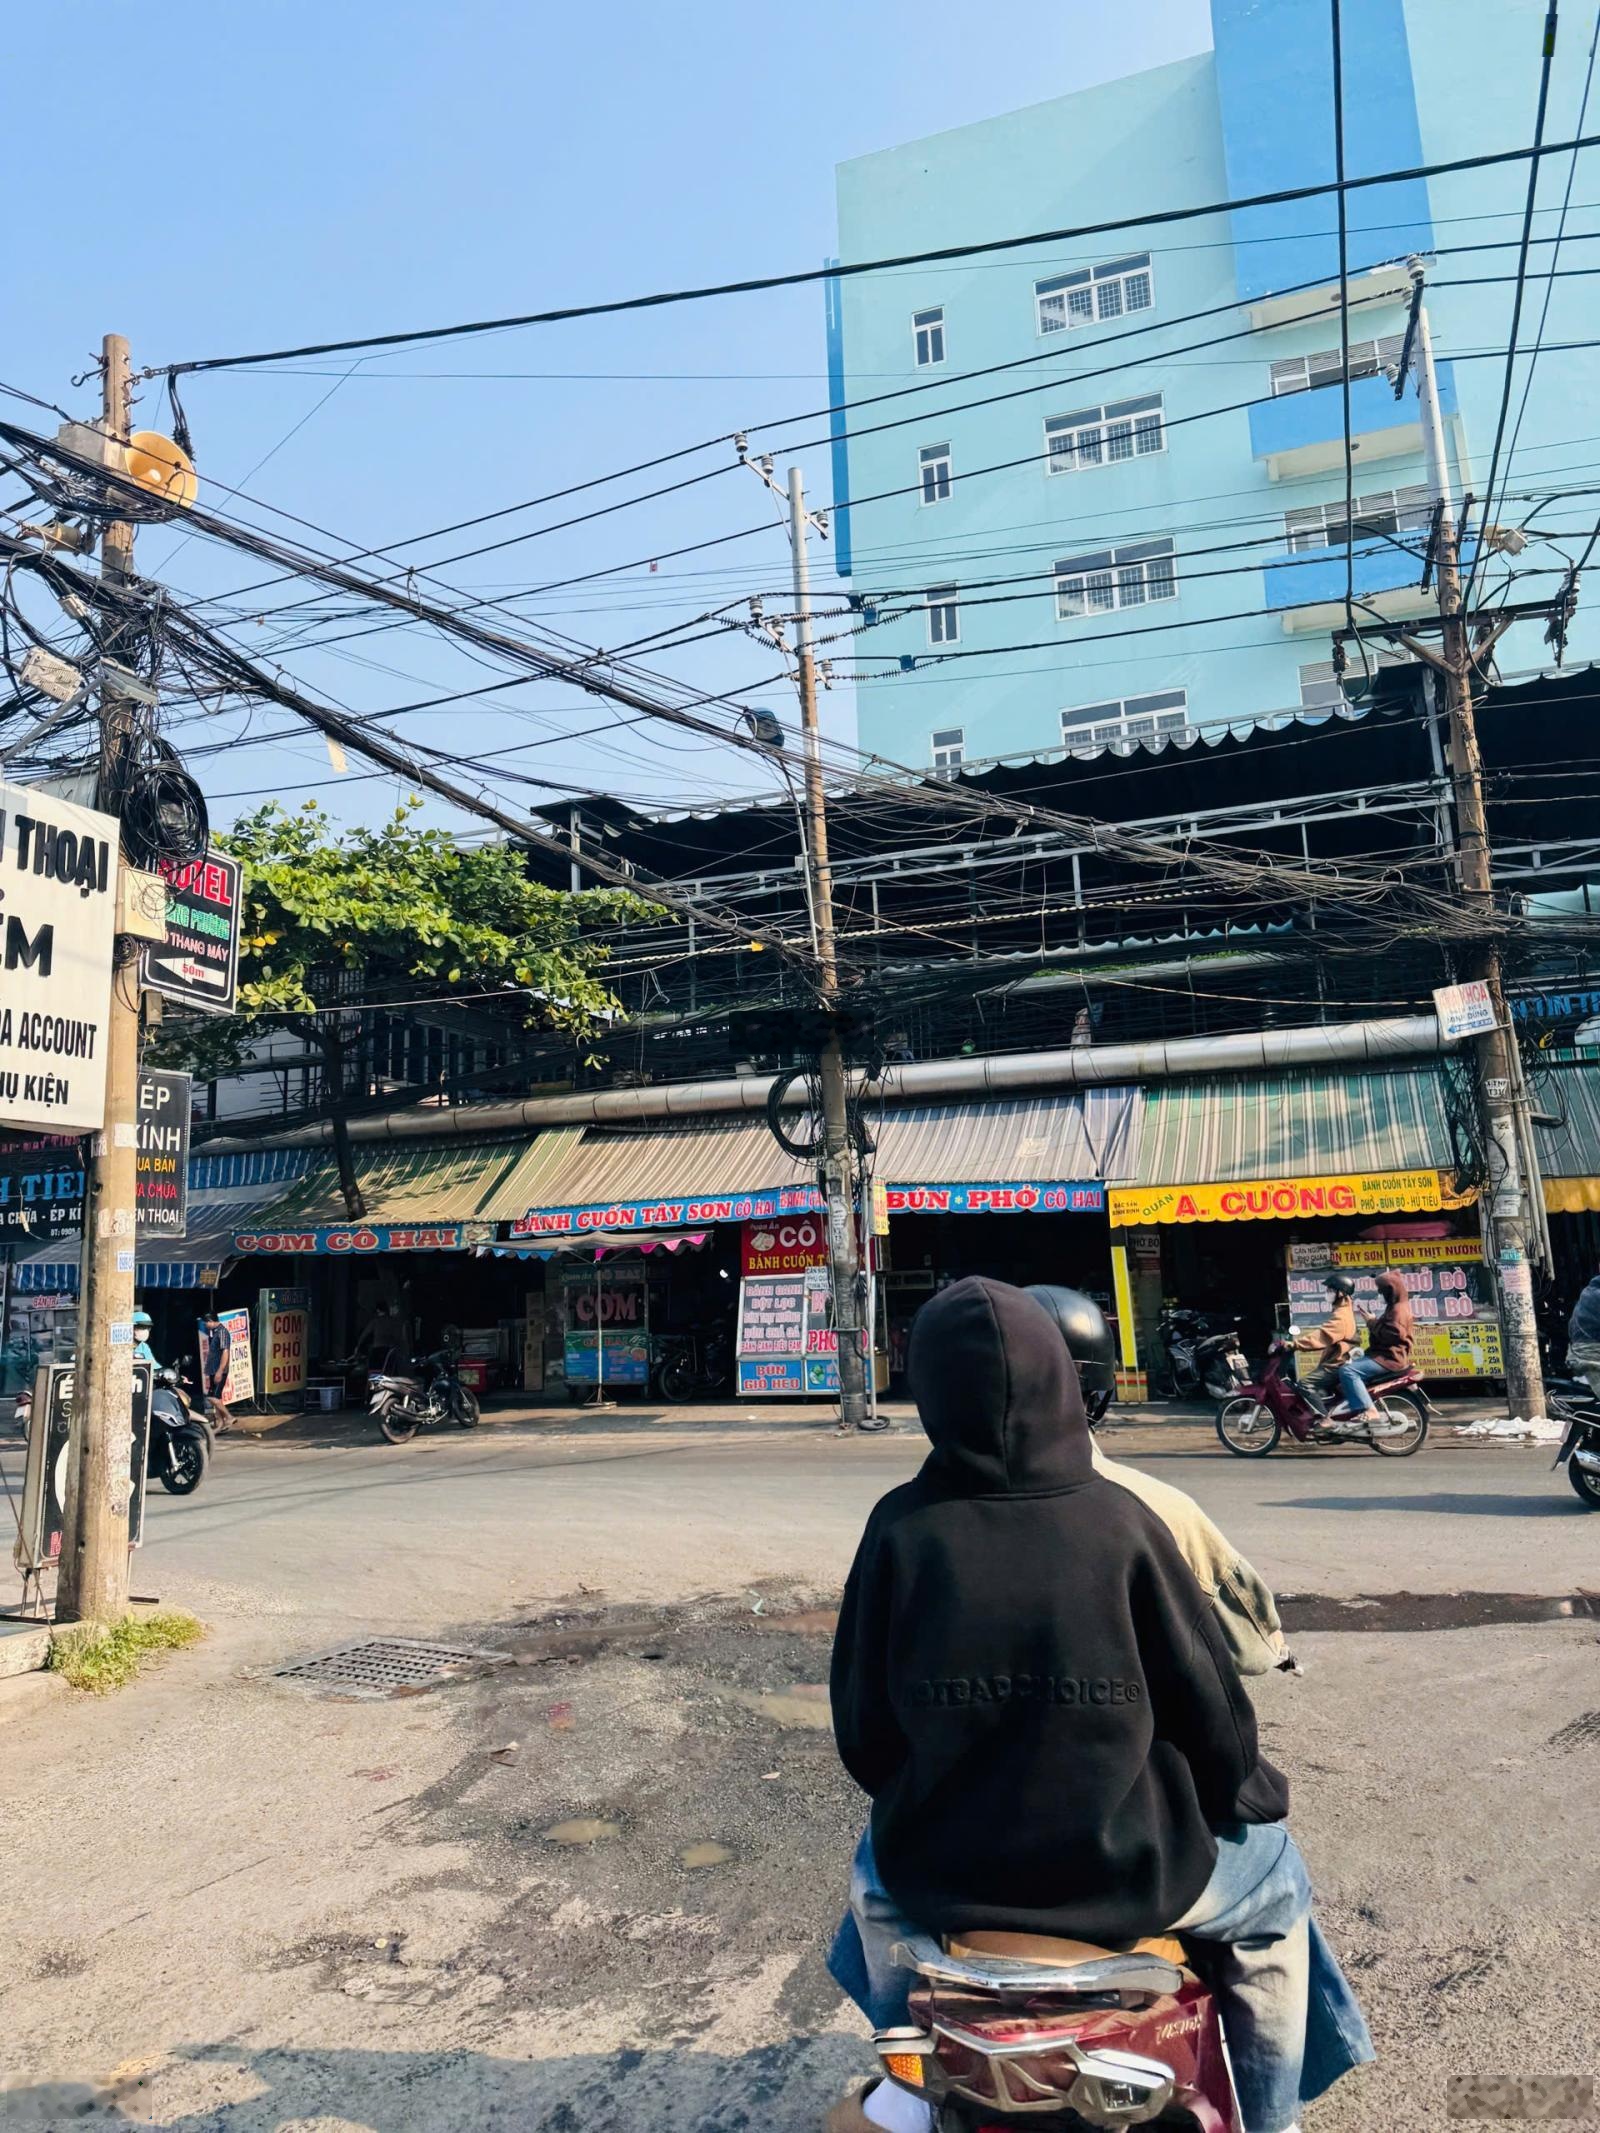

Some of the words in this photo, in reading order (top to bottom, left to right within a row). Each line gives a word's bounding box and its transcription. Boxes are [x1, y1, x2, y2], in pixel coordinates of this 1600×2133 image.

[15, 815, 109, 898] THOẠI
[170, 932, 205, 956] THANG
[207, 943, 229, 963] MÁY
[18, 1012, 97, 1060] ACCOUNT
[25, 1072, 69, 1108] KIỆN
[140, 1079, 171, 1111] ÉP
[137, 1160, 151, 1172] UA
[887, 1187, 951, 1209] BÚN
[967, 1184, 1041, 1209] PHỞ
[1044, 1187, 1067, 1209] CÔ
[1072, 1189, 1101, 1208] HAI
[1221, 1183, 1356, 1217] CƯỜNG
[50, 1203, 65, 1222] ÉP
[149, 1209, 179, 1227] THOẠI
[576, 1204, 636, 1229] CUỐN
[641, 1202, 684, 1224] TÂY
[688, 1201, 732, 1220] SƠN
[735, 1197, 752, 1217] CÔ
[754, 1199, 776, 1215] HAI
[235, 1232, 317, 1251] CƠM
[326, 1227, 379, 1250] CÔ
[389, 1228, 458, 1249] HAI
[779, 1219, 817, 1249] CÔ
[748, 1253, 781, 1270] BÁNH
[783, 1248, 814, 1268] CUỐN
[1405, 1266, 1433, 1292] HỞ
[1440, 1266, 1467, 1291] BÒ
[1409, 1294, 1439, 1318] ÚN
[1444, 1291, 1473, 1317] BÒ
[273, 1311, 303, 1335] CƠM
